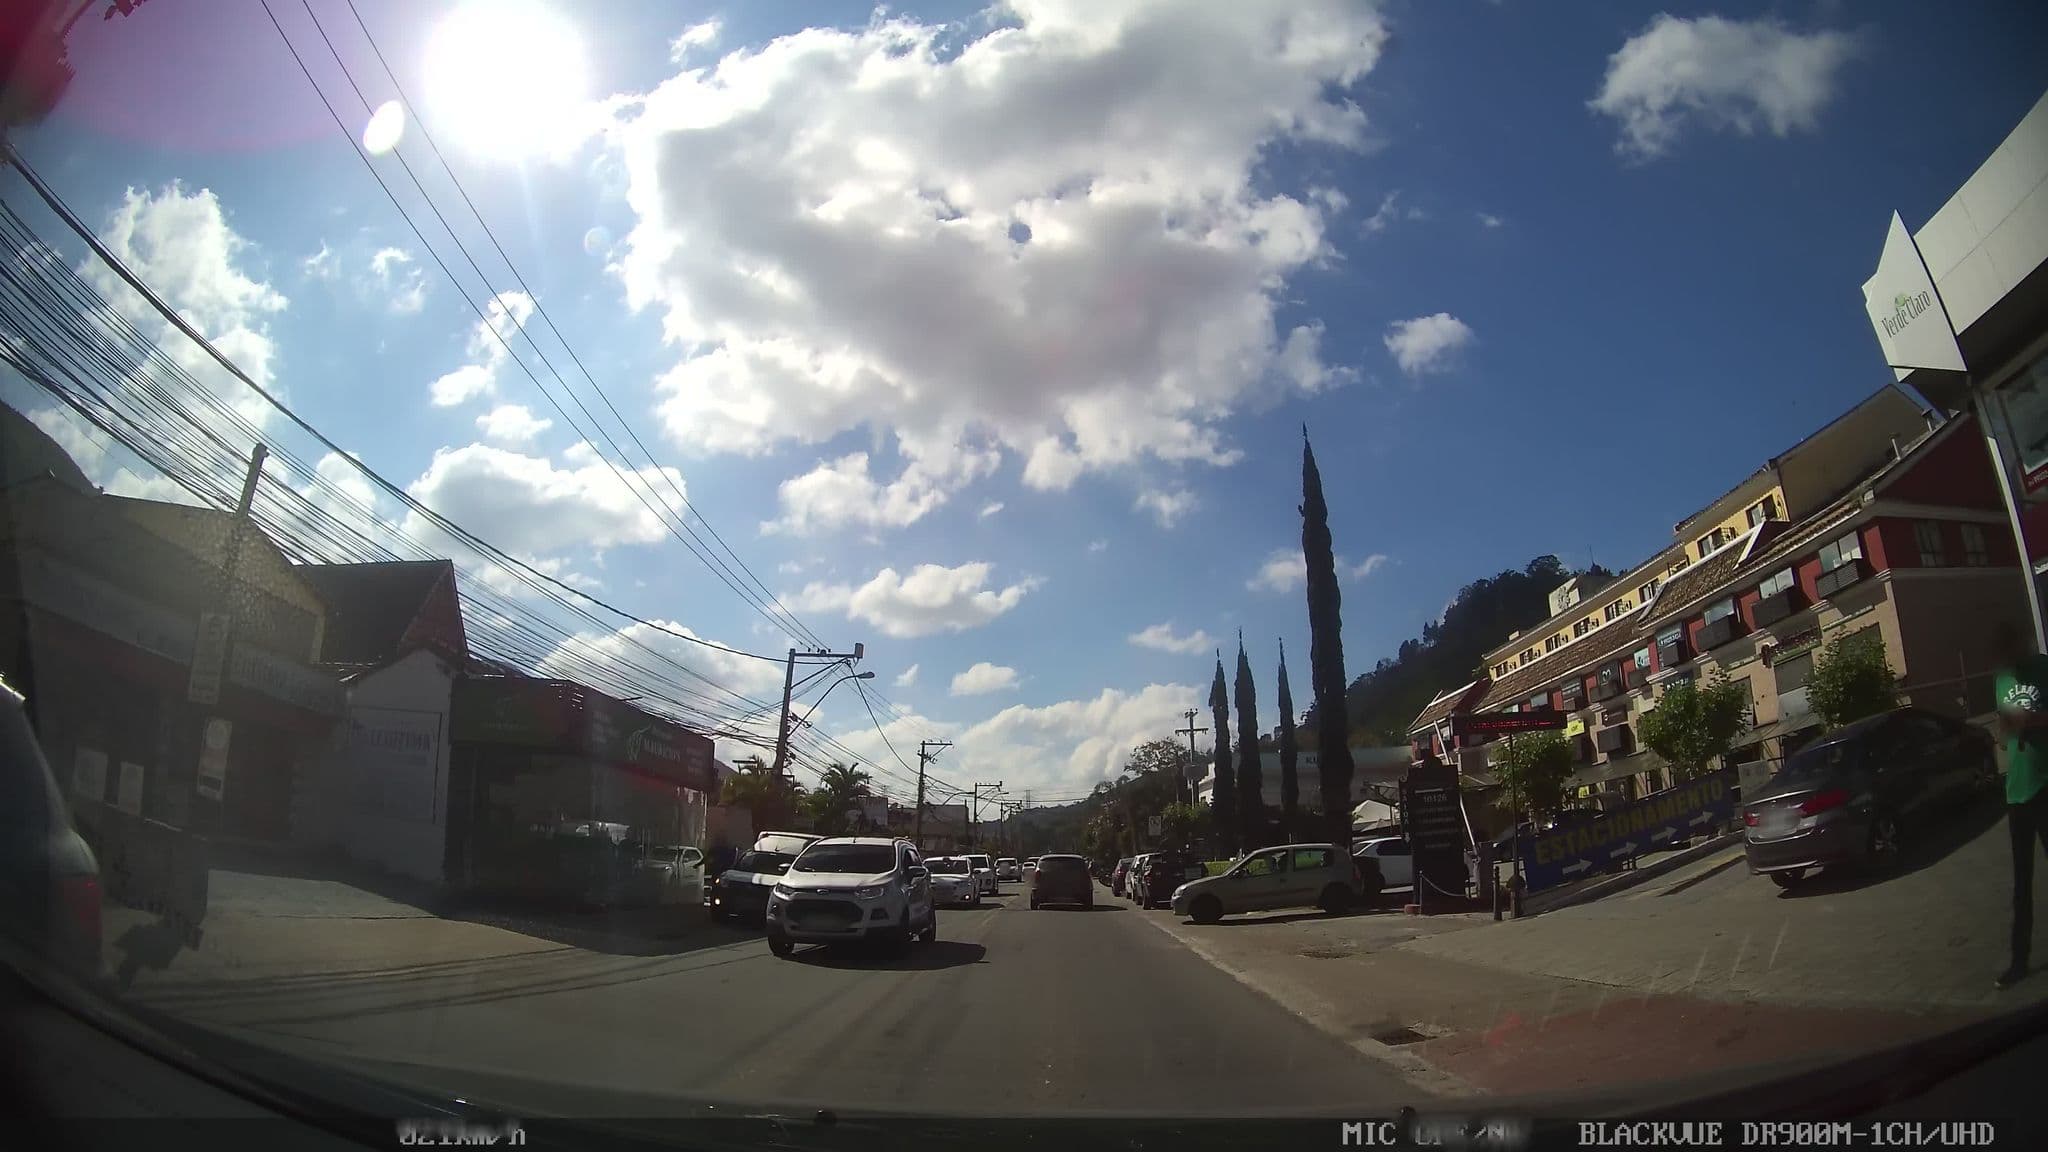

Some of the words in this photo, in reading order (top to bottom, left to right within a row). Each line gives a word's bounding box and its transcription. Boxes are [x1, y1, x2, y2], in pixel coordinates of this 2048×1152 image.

[1881, 308, 1910, 339] Verde
[1904, 290, 1931, 321] Claro
[1535, 777, 1724, 866] ESTACIONAMENTO
